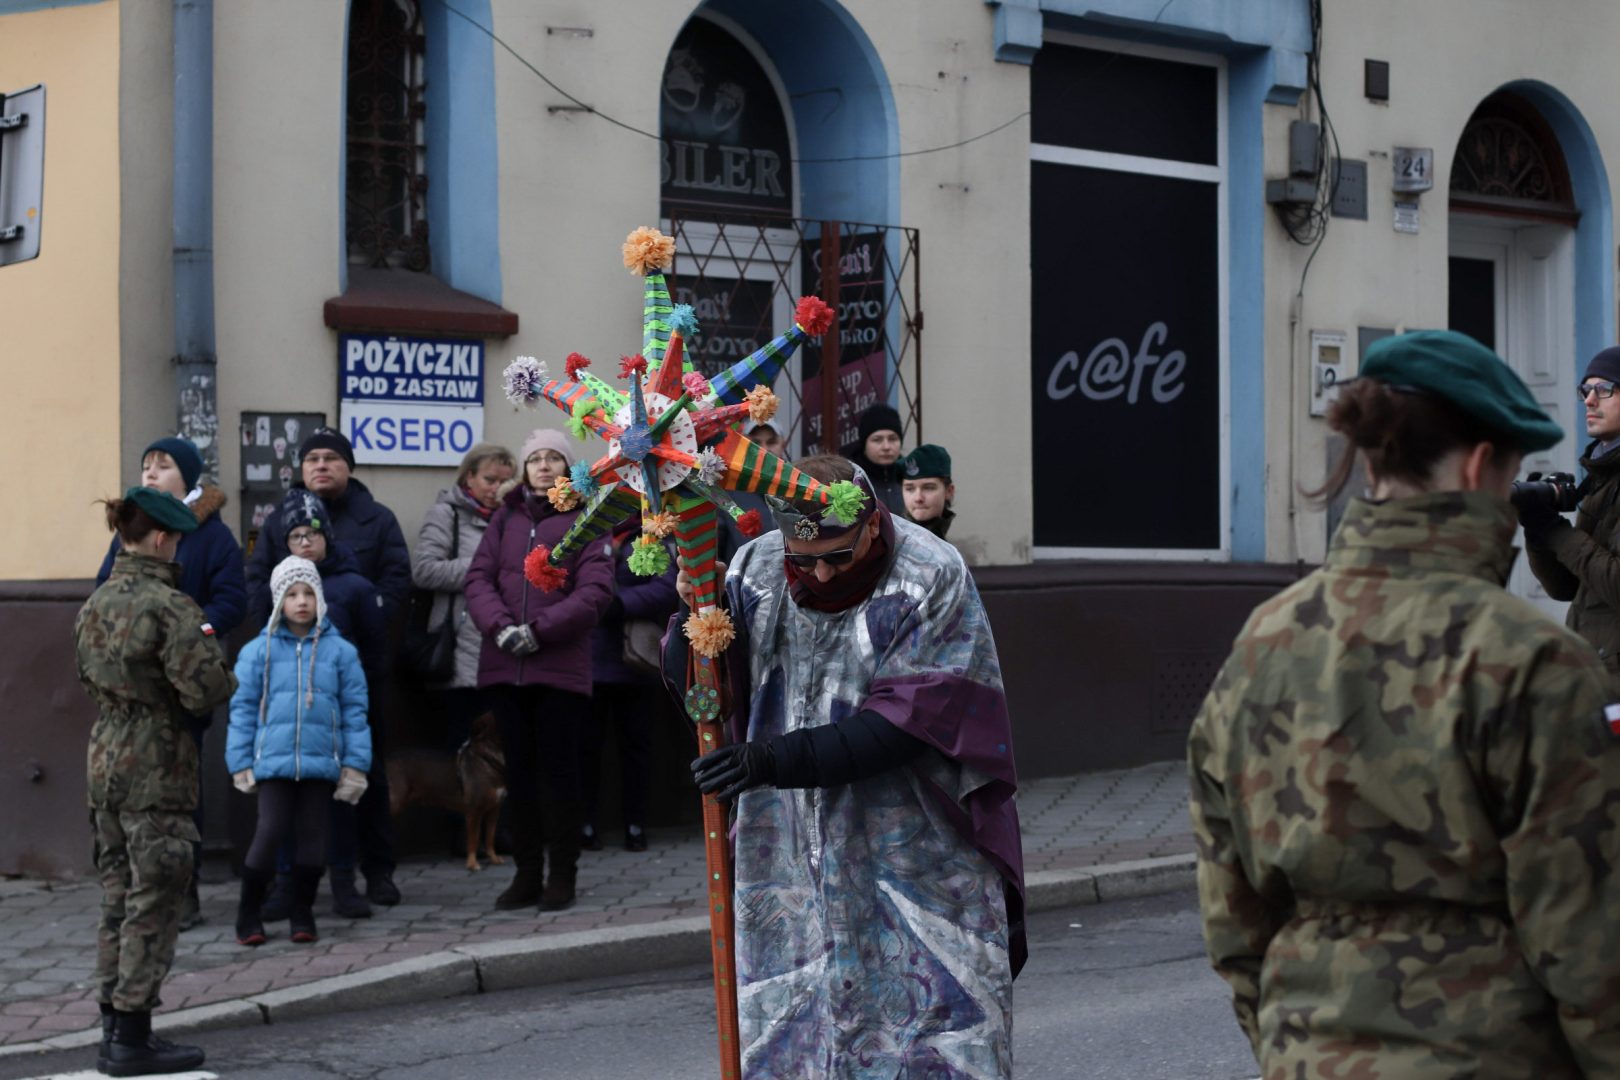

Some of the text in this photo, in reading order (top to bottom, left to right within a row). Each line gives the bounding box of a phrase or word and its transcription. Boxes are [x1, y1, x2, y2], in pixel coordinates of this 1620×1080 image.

[1402, 156, 1424, 177] 24
[346, 336, 479, 376] POŻYCZKI
[1047, 321, 1187, 405] c@fe
[346, 375, 478, 398] POD ZASTAW
[351, 416, 473, 453] KSERO
